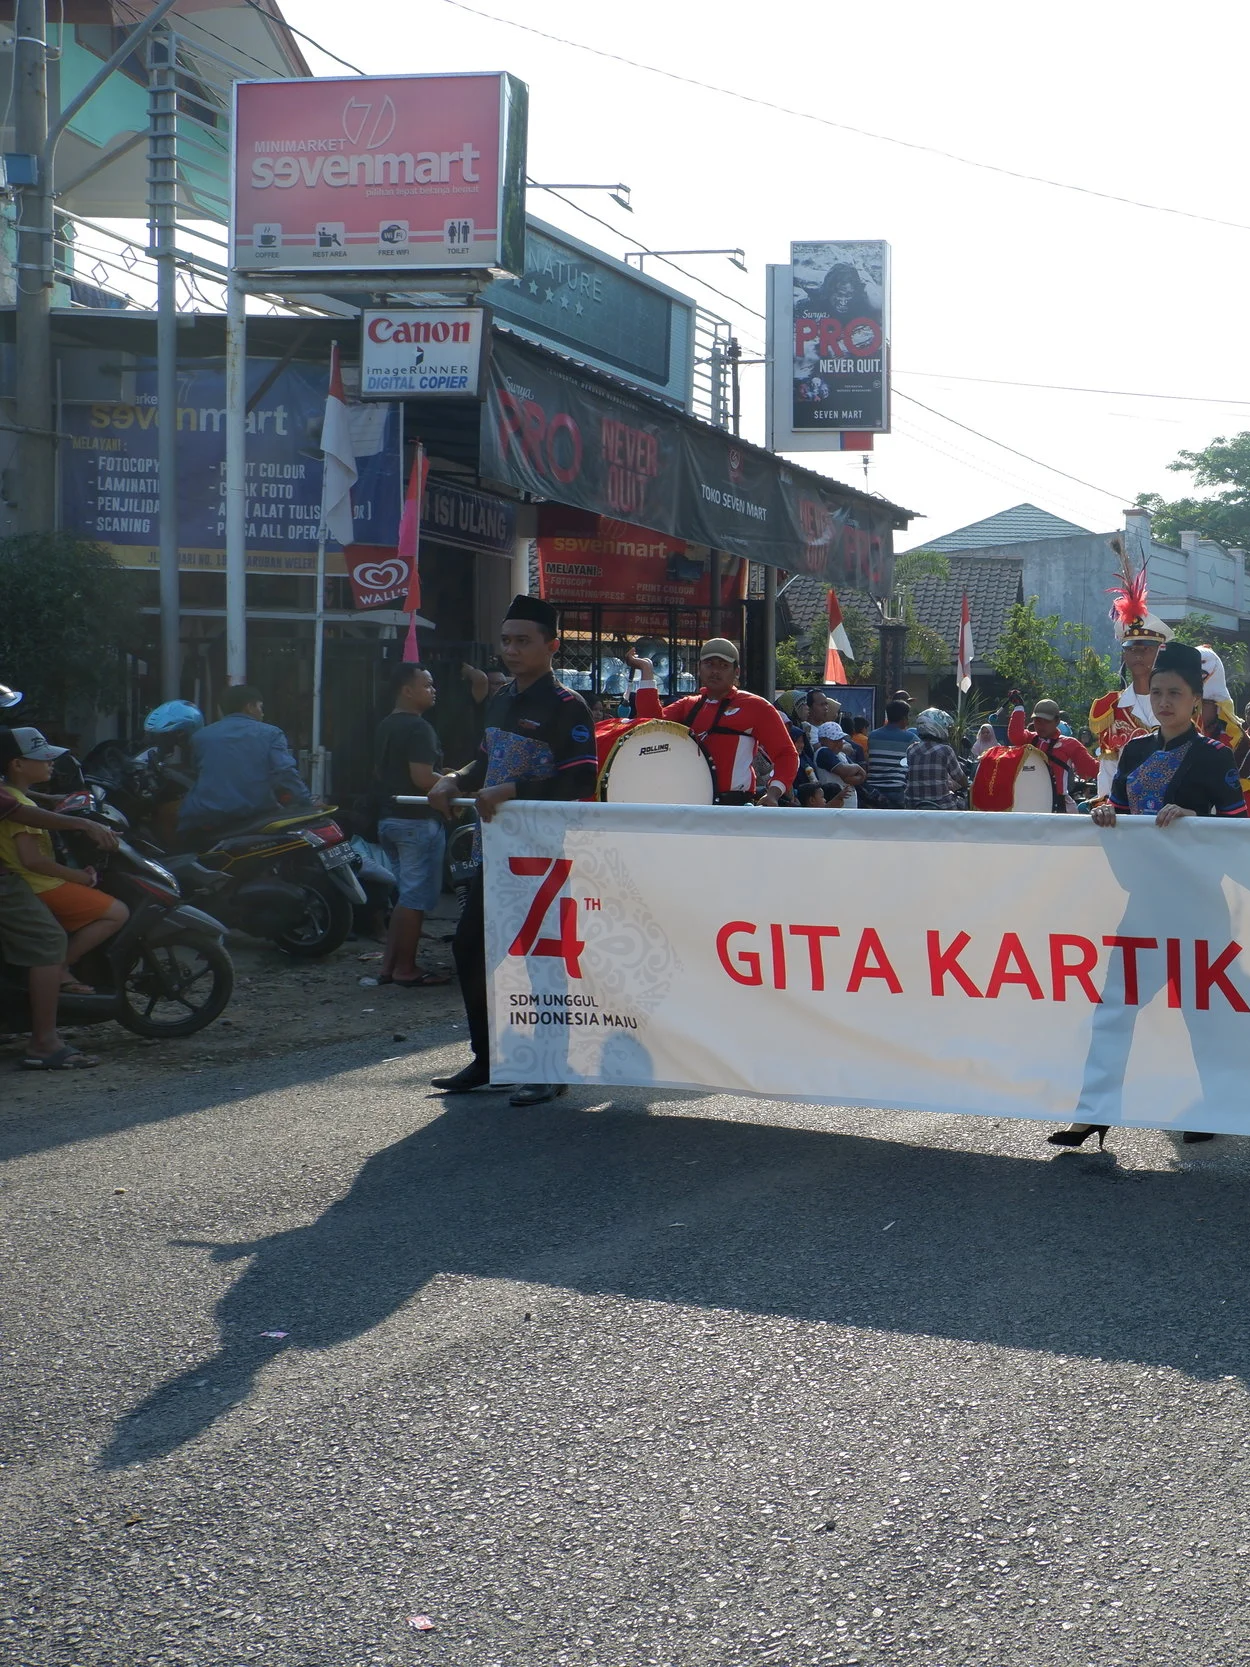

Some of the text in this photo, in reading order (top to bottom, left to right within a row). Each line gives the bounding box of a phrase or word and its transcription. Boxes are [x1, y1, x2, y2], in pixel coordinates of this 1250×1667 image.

[254, 138, 347, 153] MINIMARKET
[252, 142, 481, 189] sevenmart
[255, 251, 280, 259] COFFEE
[312, 251, 327, 259] REST
[803, 309, 830, 323] Surya
[367, 318, 471, 344] Canon
[795, 317, 882, 356] PRO
[367, 365, 468, 377] imageRUNNER
[819, 359, 854, 373] NEVER
[367, 375, 468, 390] DIGITAL COPIER
[505, 376, 535, 399] Surya
[90, 404, 288, 436] sevnmart
[814, 410, 863, 419] SEVEN MART
[497, 387, 583, 485] PRO
[601, 418, 658, 478] NEVER
[259, 463, 306, 480] COLOUR
[261, 483, 294, 500] FOTO
[97, 497, 160, 514] PENJILIDA
[701, 484, 768, 522] TOKO SEVEN MART
[253, 504, 321, 520] ALAT TULIS
[434, 493, 455, 528] ISI
[459, 502, 507, 541] ULANG
[96, 517, 151, 533] SCANING
[260, 524, 284, 539] ALL
[553, 537, 668, 559] sevenmart
[551, 576, 592, 587] FOTOCOPY
[359, 587, 409, 605] WALL'S
[639, 743, 670, 757] ROLLING
[584, 897, 601, 911] TH
[716, 920, 903, 994] GITA
[510, 994, 599, 1008] SDM UNGGUL
[510, 1011, 638, 1030] INDONESIA MAJU
